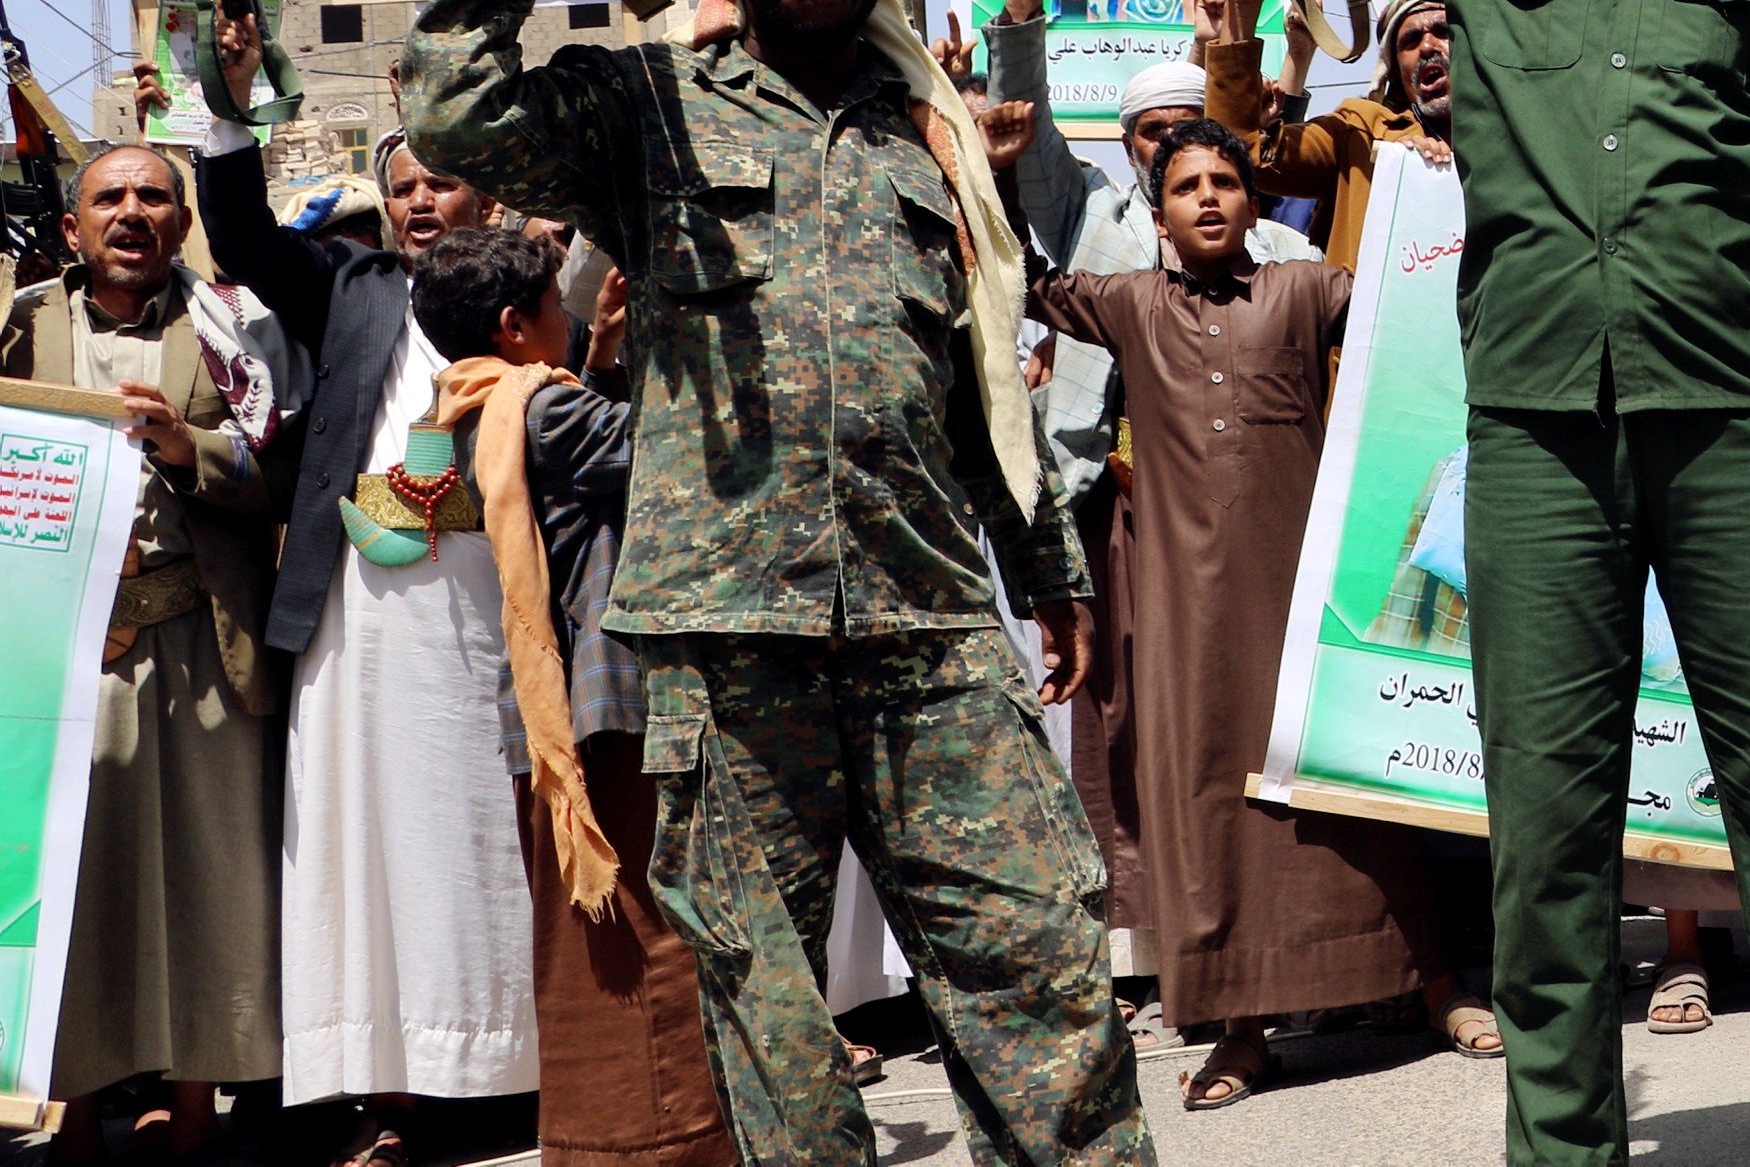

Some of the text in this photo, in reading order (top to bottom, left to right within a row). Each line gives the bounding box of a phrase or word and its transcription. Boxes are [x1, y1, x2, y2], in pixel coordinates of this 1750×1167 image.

[1047, 37, 1081, 65] علي
[1081, 37, 1156, 62] عبدالوهاب
[1401, 232, 1465, 273] ضحيان
[2, 442, 84, 466] الله أكبر
[45, 473, 79, 486] الموت
[40, 491, 76, 505] الموت
[30, 524, 69, 544] النصر
[1379, 673, 1463, 709] الحمران
